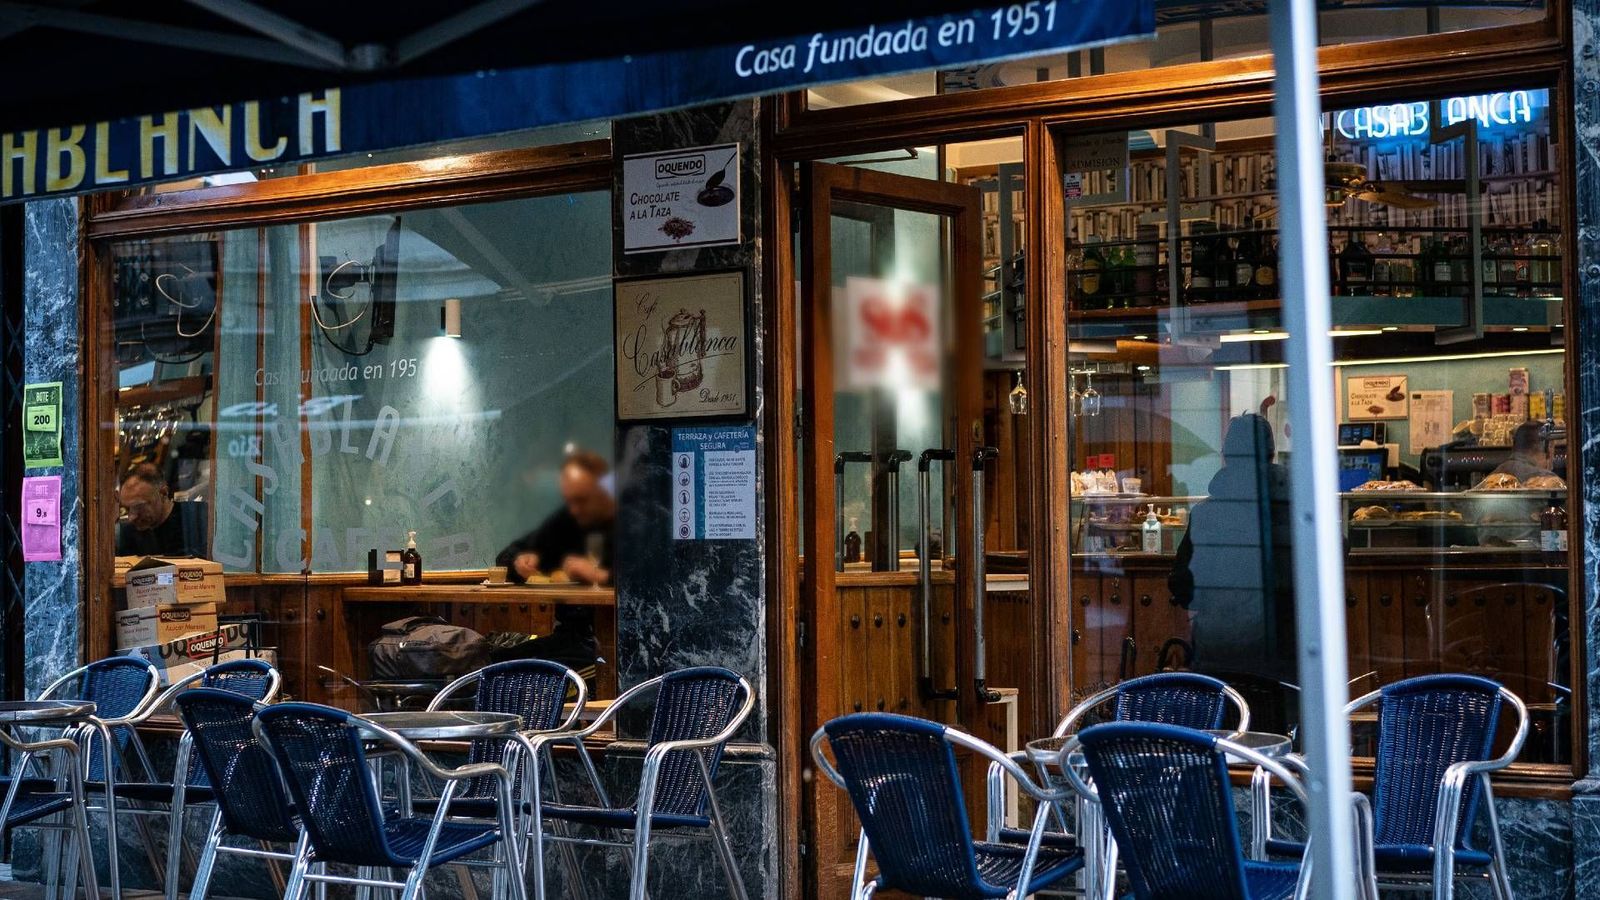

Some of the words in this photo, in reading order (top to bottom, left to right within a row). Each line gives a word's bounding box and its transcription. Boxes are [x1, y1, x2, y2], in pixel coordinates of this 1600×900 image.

[735, 44, 796, 78] Casa
[803, 19, 928, 74] fundada
[937, 18, 975, 48] en
[990, 1, 1057, 41] 1951
[1337, 90, 1531, 139] CASABANCA
[658, 159, 703, 176] OQUENDO
[630, 191, 680, 206] CHOCOLATE
[629, 211, 636, 220] A
[637, 210, 647, 220] LA
[649, 205, 672, 218] TAZA
[363, 364, 383, 380] en
[390, 358, 417, 378] 195
[34, 414, 51, 426] 200
[677, 433, 708, 441] TERRAZA
[708, 433, 713, 442] y
[699, 442, 727, 450] SEGURA
[179, 570, 203, 581] OQUENDO
[161, 611, 189, 622] OQUENDO
[190, 636, 224, 653] OQUENO
